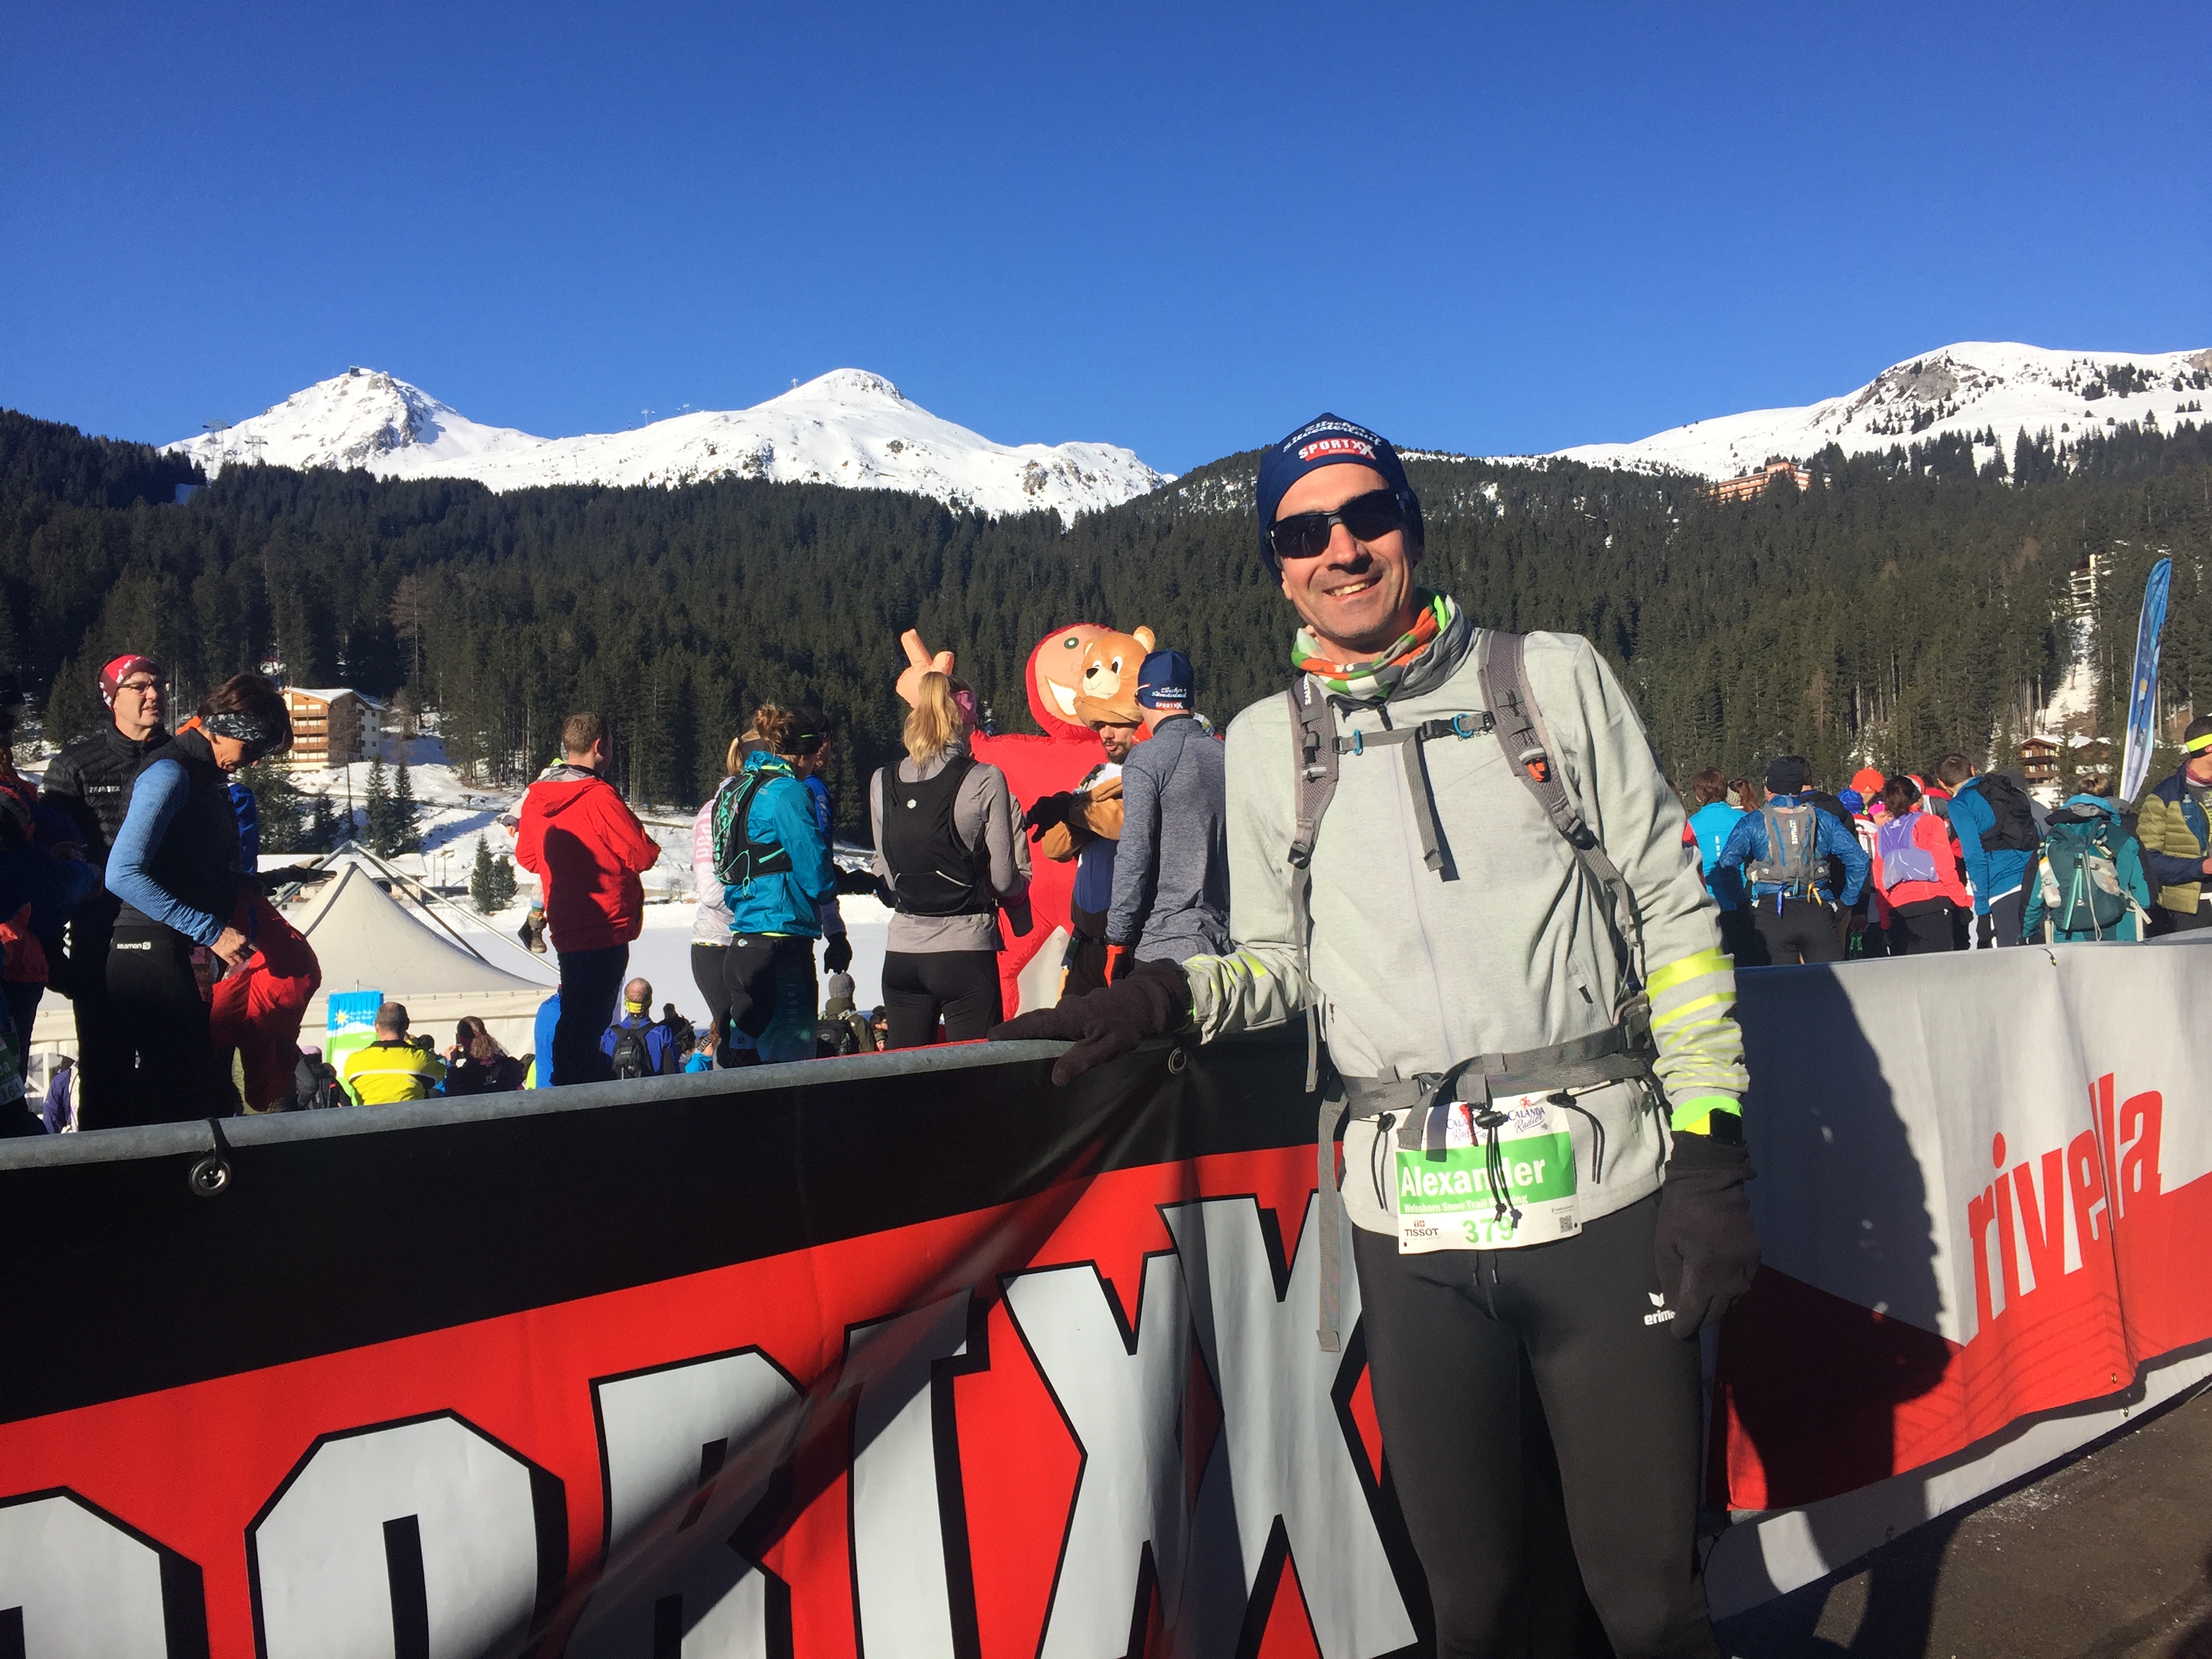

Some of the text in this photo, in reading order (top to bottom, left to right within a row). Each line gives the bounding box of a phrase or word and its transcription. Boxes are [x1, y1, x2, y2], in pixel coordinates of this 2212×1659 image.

[1298, 439, 1377, 460] SPORTXX
[1507, 1107, 1546, 1121] CALANDA
[1401, 1157, 1546, 1197] Alexander
[1404, 1195, 1529, 1213] Weisshorn Snow Trail Ring
[1404, 1227, 1439, 1237] TISSOT
[1462, 1216, 1515, 1244] 379
[0, 1195, 1418, 1659] ORTXX
